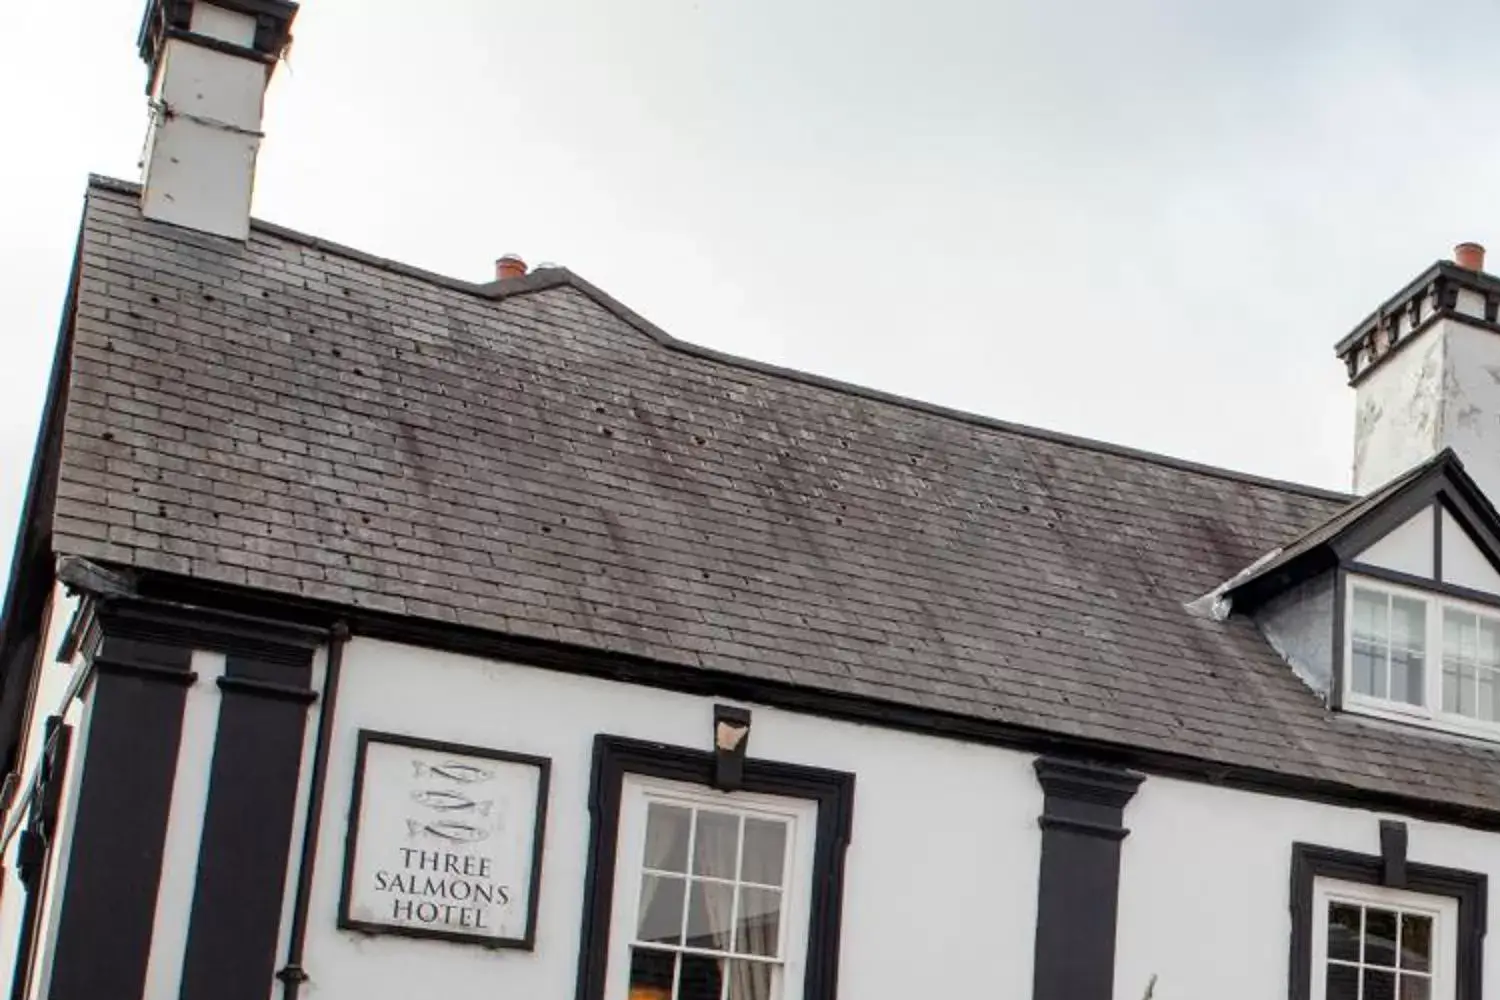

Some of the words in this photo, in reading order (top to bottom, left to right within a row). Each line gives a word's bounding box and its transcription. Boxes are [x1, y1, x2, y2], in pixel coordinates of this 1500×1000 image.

[400, 848, 491, 877] THREE
[375, 870, 509, 904] SALMONS
[393, 899, 487, 928] HOTEL
